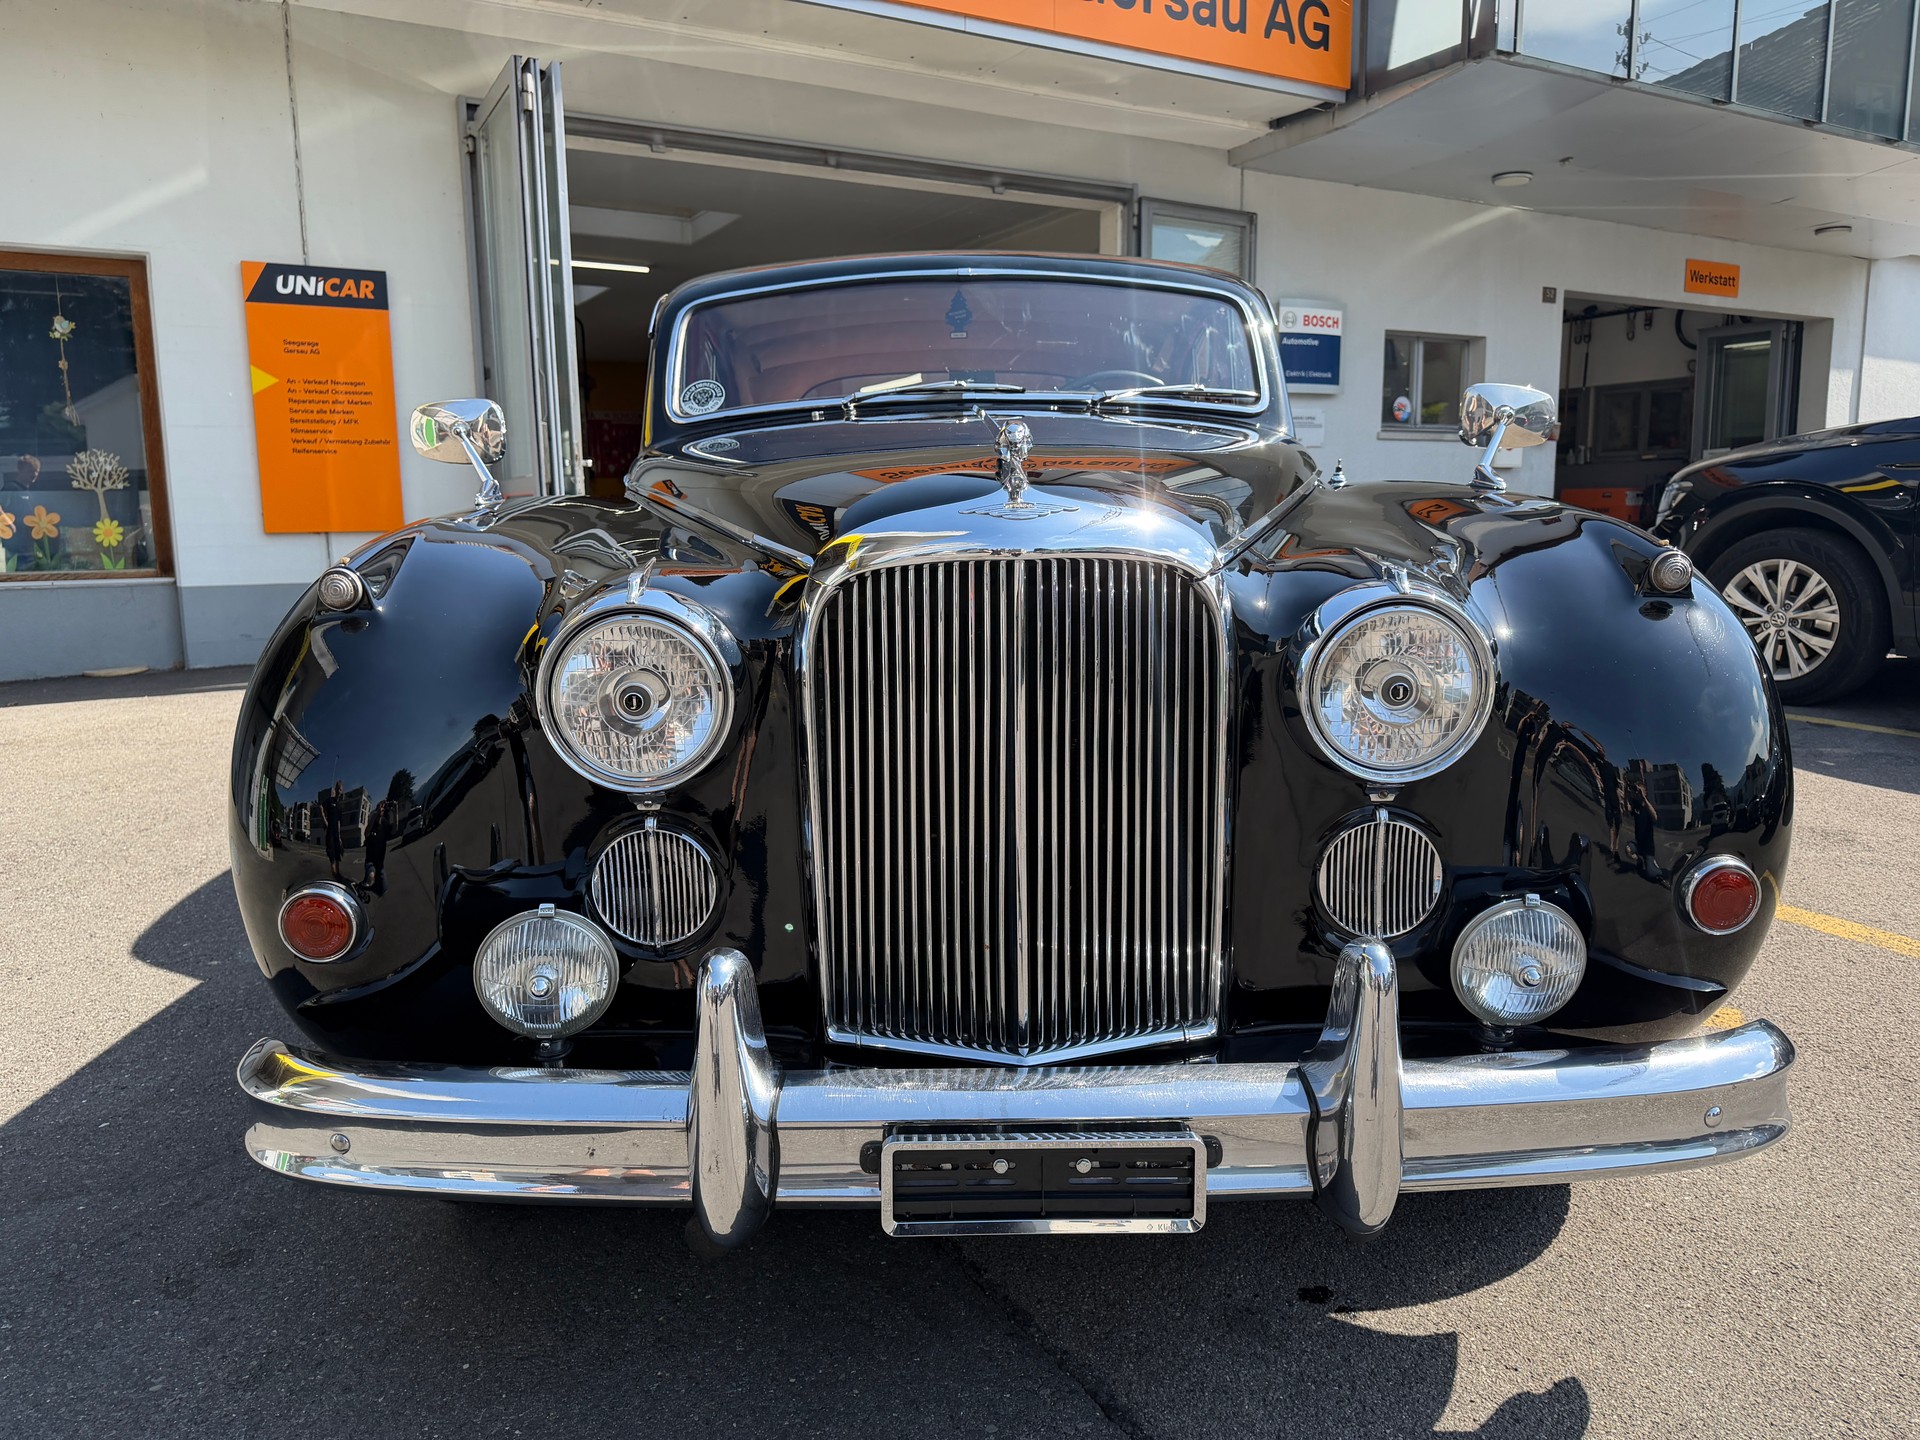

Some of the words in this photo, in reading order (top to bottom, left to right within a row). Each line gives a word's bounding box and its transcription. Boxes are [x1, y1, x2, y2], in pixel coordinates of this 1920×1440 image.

[1264, 0, 1331, 51] AG
[1689, 269, 1736, 287] Werkstatt
[1303, 314, 1339, 328] BOSCH
[283, 339, 319, 347] Seegarage
[1282, 337, 1319, 346] Automotive
[1285, 370, 1305, 378] Elektrik
[1309, 370, 1332, 378] Elektronik
[330, 379, 366, 387] Neuwagen
[290, 417, 337, 425] Bereitstellung
[324, 438, 363, 446] Vermietung
[1395, 685, 1404, 700] J
